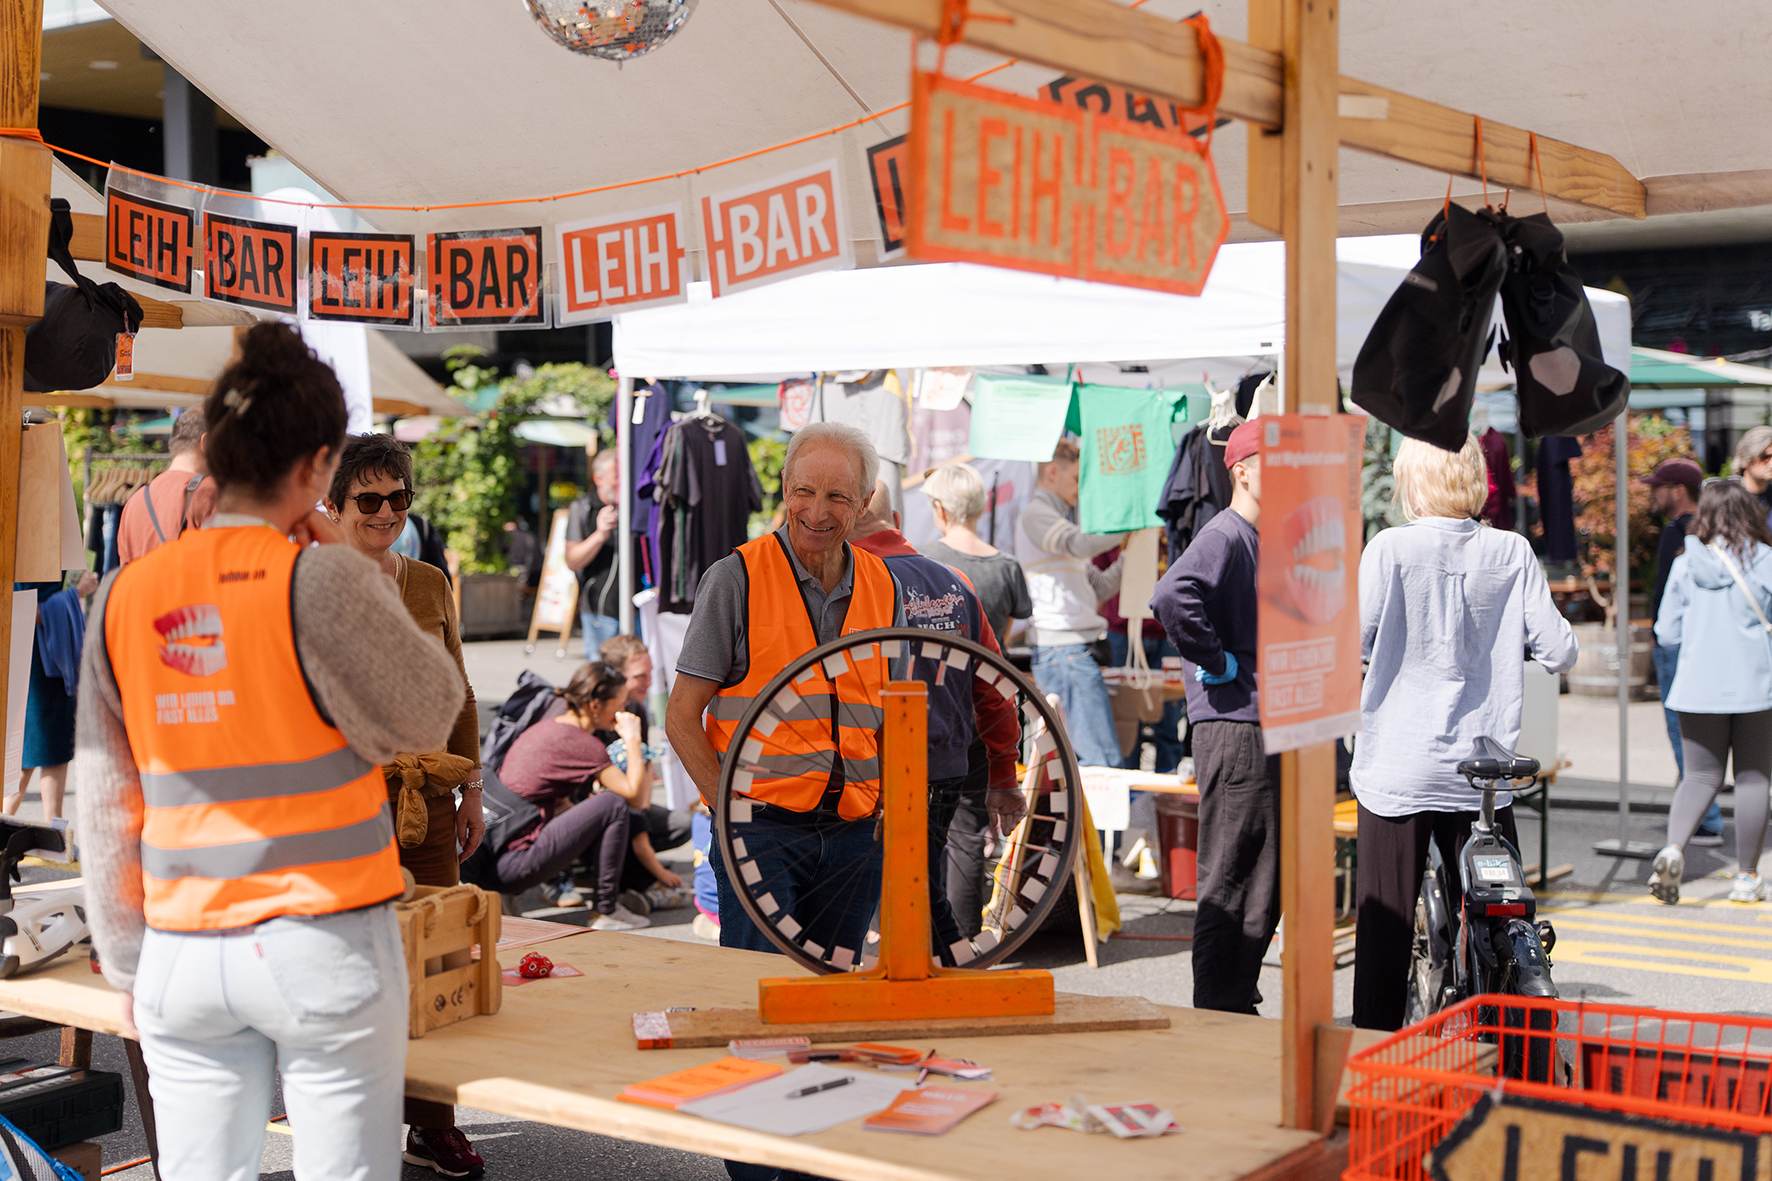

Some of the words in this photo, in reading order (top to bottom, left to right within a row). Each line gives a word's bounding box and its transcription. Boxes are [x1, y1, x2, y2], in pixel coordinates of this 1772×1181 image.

[942, 108, 1064, 249] LEIH
[1106, 146, 1198, 271] BAR
[113, 203, 178, 281] LEIH
[217, 230, 285, 298] BAR
[571, 222, 672, 304] LEIH
[728, 182, 832, 277] BAR
[320, 247, 400, 308] LEIH
[449, 245, 530, 309] BAR
